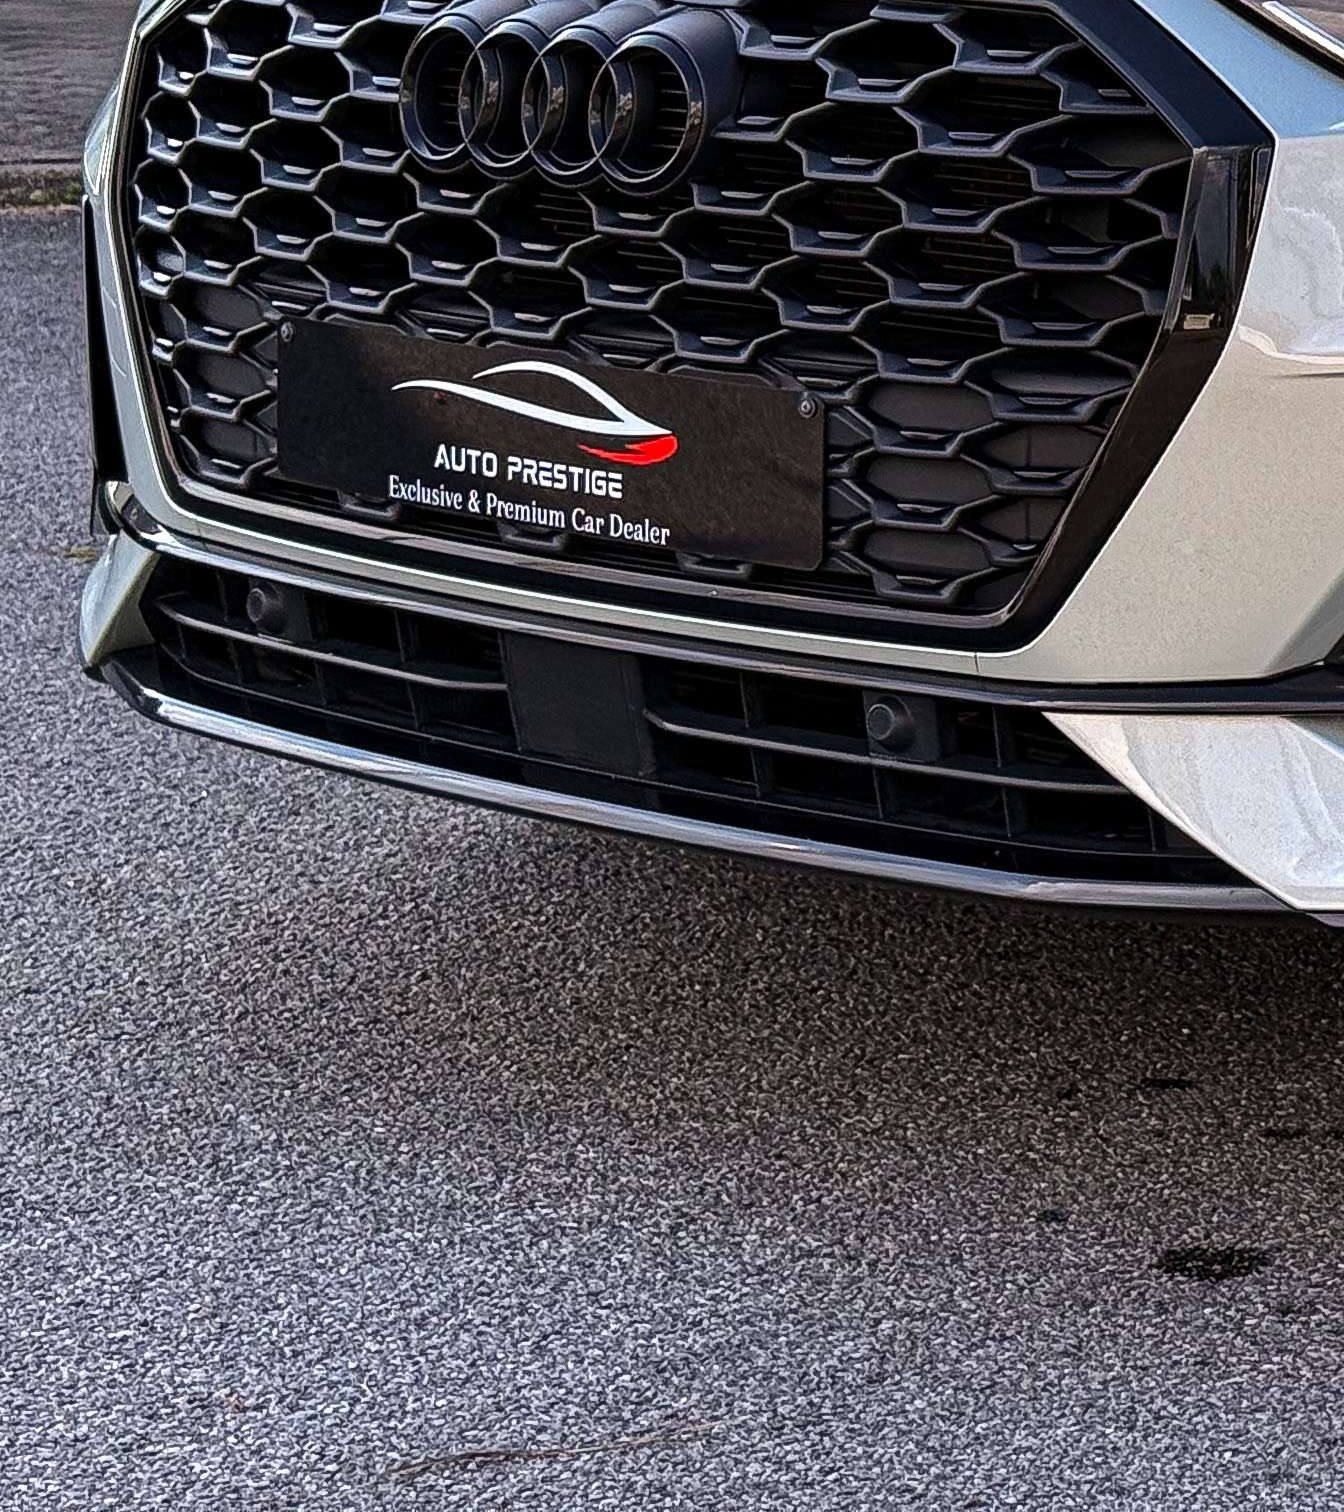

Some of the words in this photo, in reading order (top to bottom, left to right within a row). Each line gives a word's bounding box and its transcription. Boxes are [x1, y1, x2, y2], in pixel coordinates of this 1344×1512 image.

[433, 443, 498, 478] AUTO
[507, 455, 623, 499] PRESTIGE
[388, 474, 463, 510] Exclusive
[468, 489, 481, 514] &
[486, 492, 566, 529] Premium
[572, 507, 605, 535] Car
[609, 513, 671, 546] Dealer
